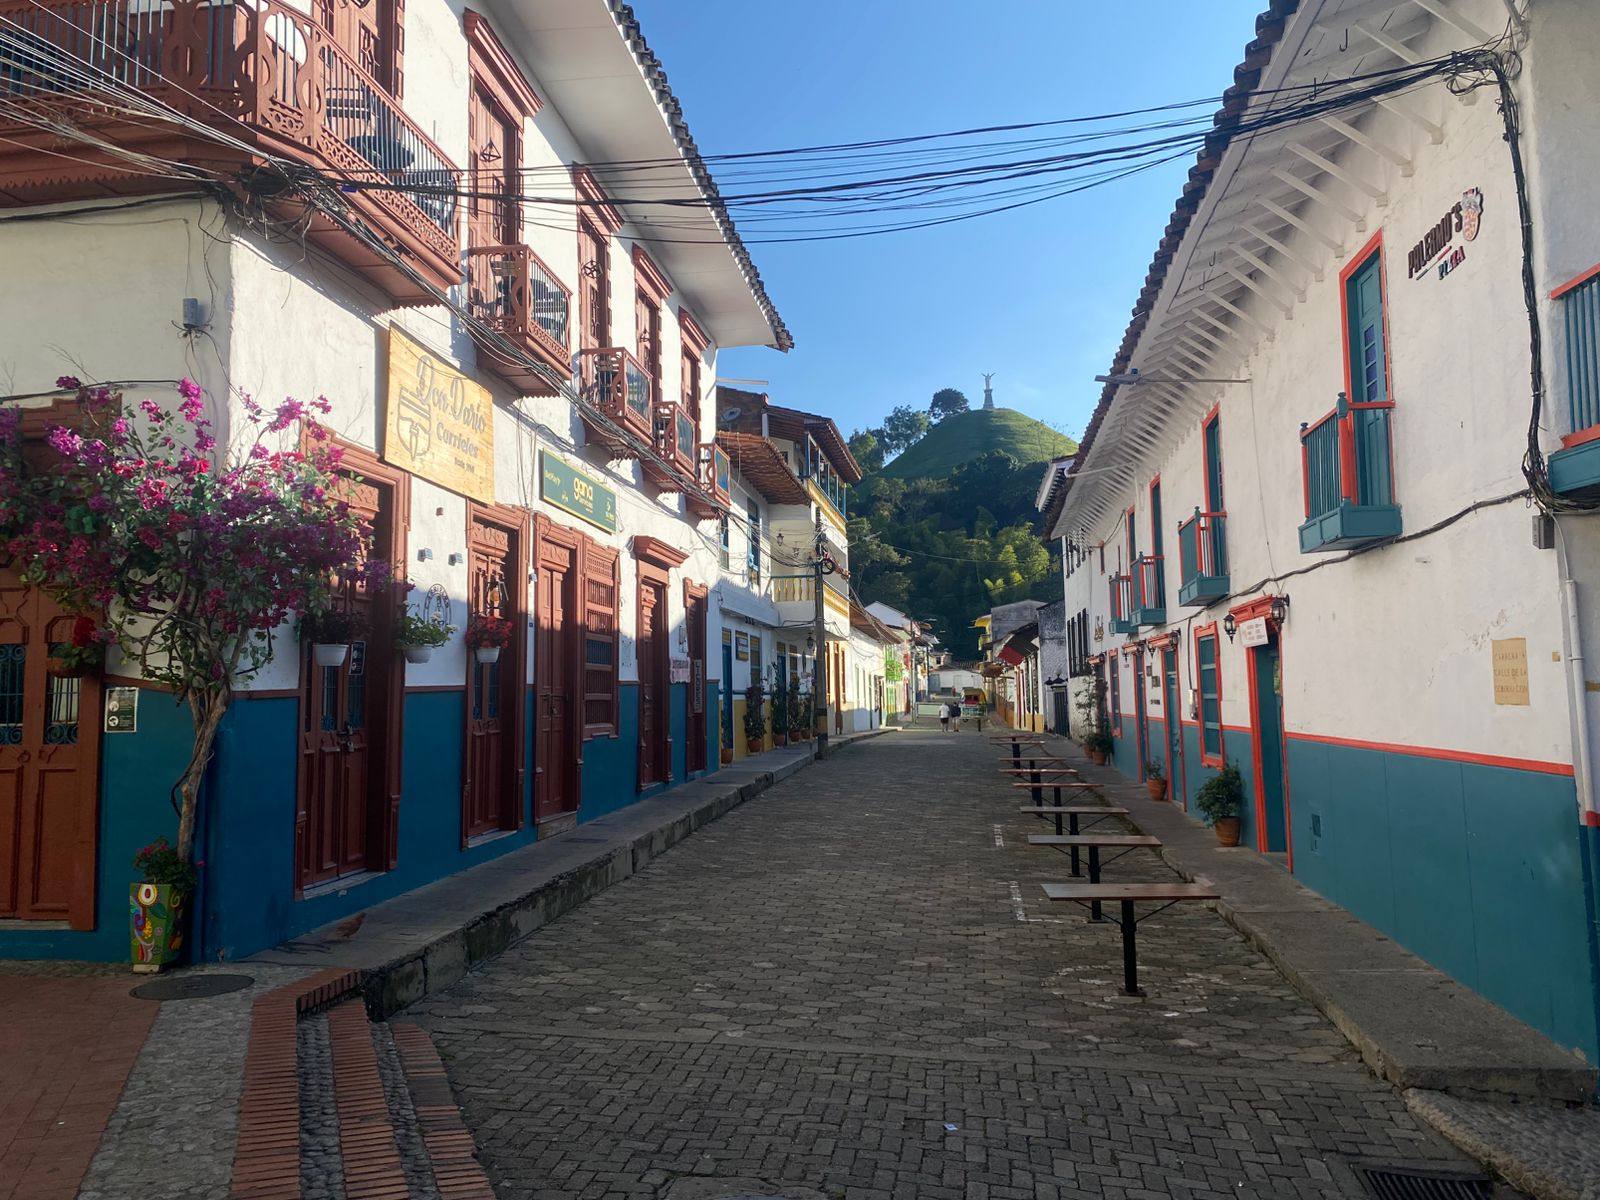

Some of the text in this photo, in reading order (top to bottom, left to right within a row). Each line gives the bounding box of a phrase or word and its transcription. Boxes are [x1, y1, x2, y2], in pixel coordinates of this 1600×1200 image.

[417, 355, 449, 411] Don
[437, 422, 479, 458] Carrieles
[574, 477, 593, 501] gana
